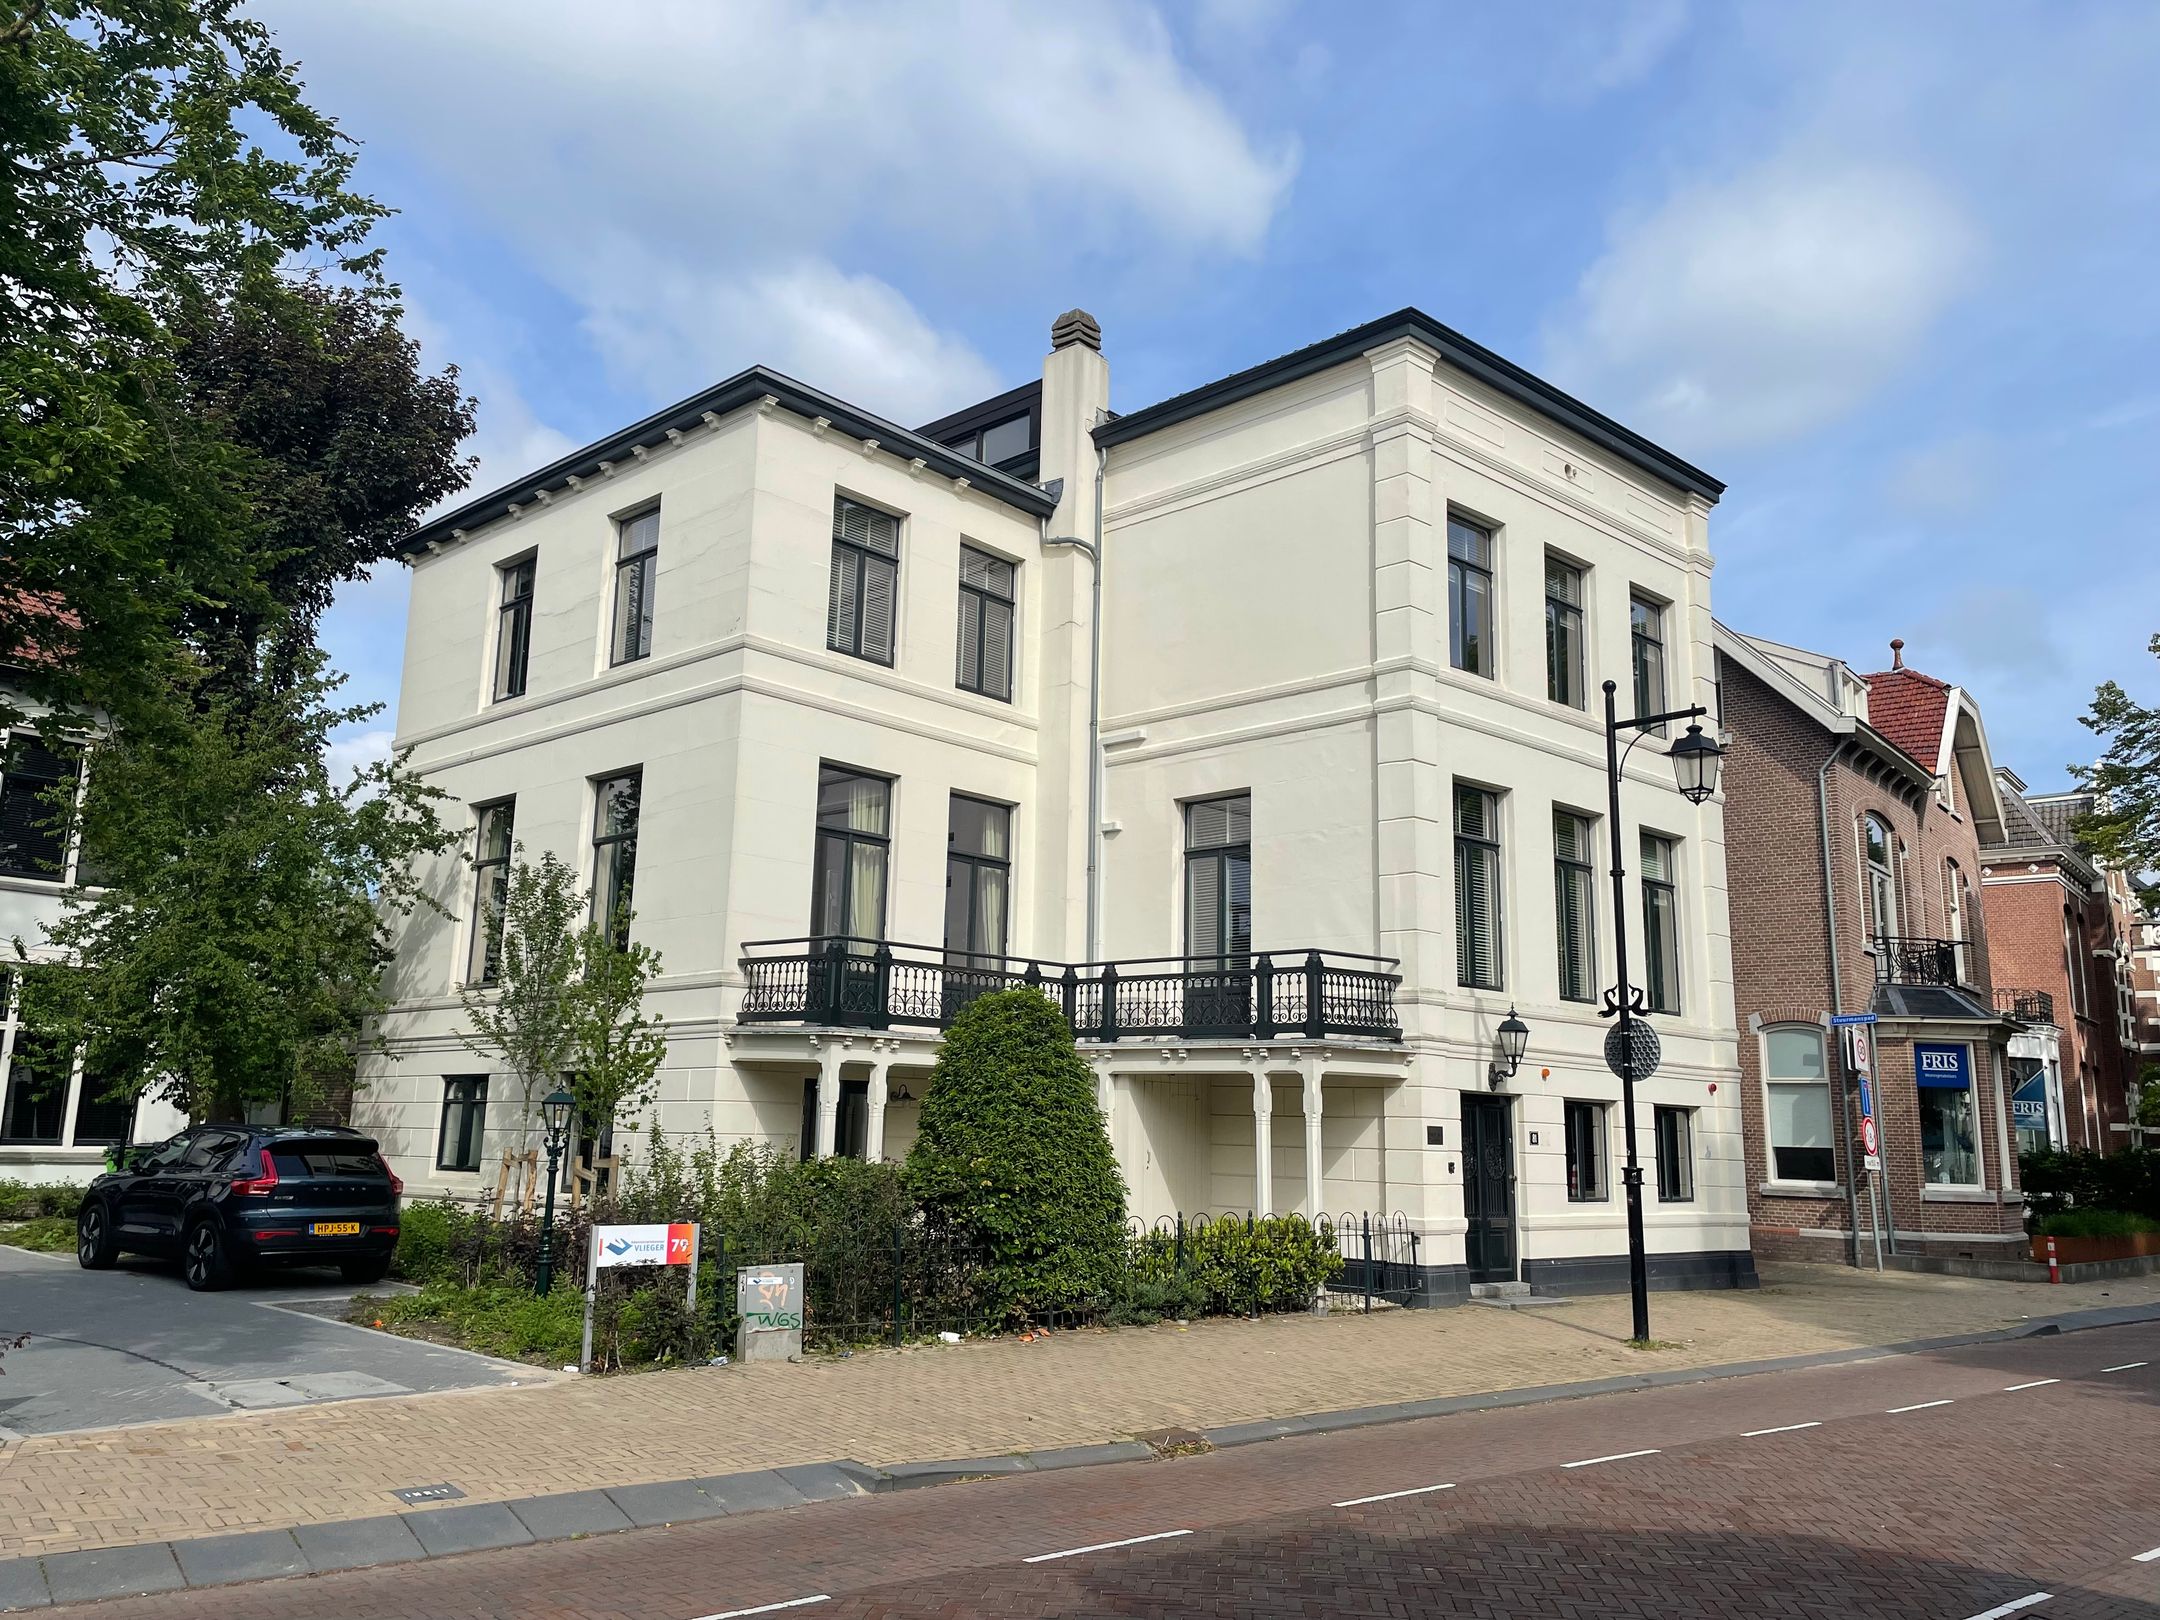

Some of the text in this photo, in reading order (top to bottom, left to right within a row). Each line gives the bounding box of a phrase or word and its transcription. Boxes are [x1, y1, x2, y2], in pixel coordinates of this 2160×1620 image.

[1921, 1054, 1958, 1069] FRIS
[317, 1224, 356, 1233] HPJ-55-K
[634, 1244, 665, 1252] VLIEGER
[671, 1238, 689, 1252] 79
